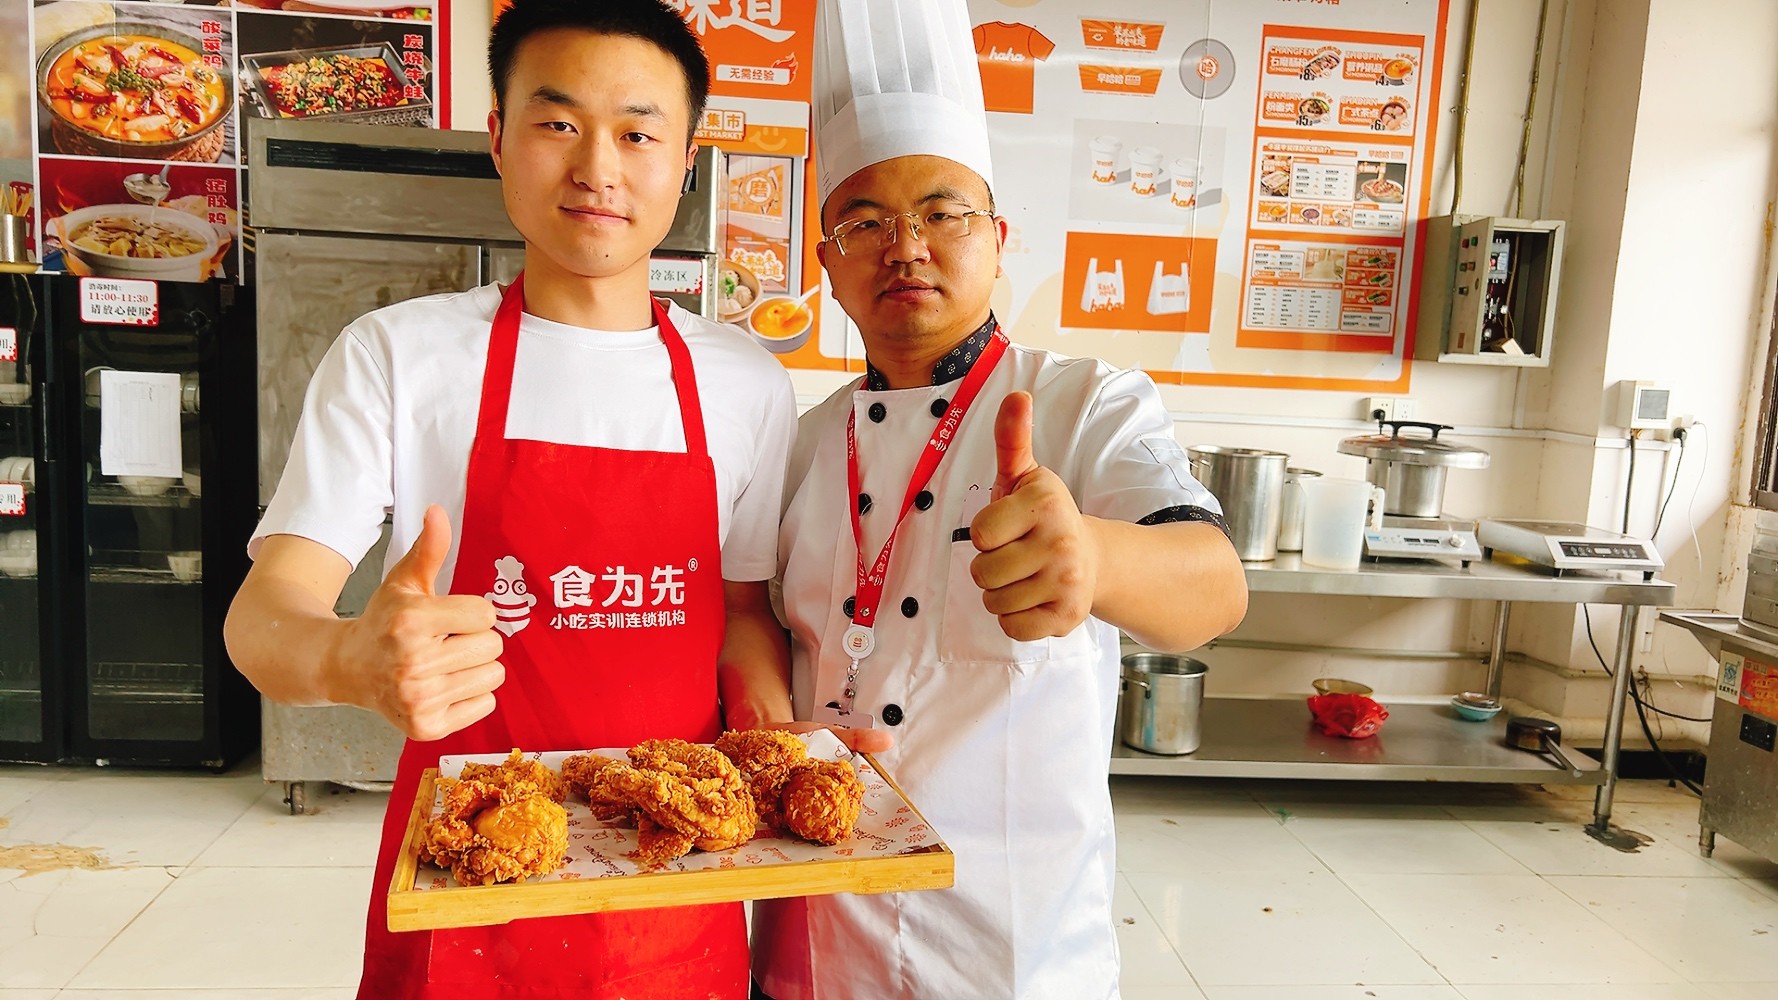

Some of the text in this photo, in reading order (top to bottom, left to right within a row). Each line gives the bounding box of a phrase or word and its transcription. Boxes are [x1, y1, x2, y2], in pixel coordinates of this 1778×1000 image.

[201, 20, 223, 71] 酸菜鸡
[989, 46, 1026, 62] haha
[403, 34, 425, 100] 炭烧牛蛙
[730, 67, 775, 82] 无需经验
[697, 112, 742, 129] 集市
[205, 178, 228, 226] 猪肚鸡
[650, 269, 688, 281] 冷冻区
[89, 292, 149, 303] 11:00-11:30
[91, 303, 151, 317] 请放心使用
[939, 406, 964, 440] 食为先
[549, 564, 685, 608] 食为先
[550, 609, 686, 631] 小吃实训连锁机构
